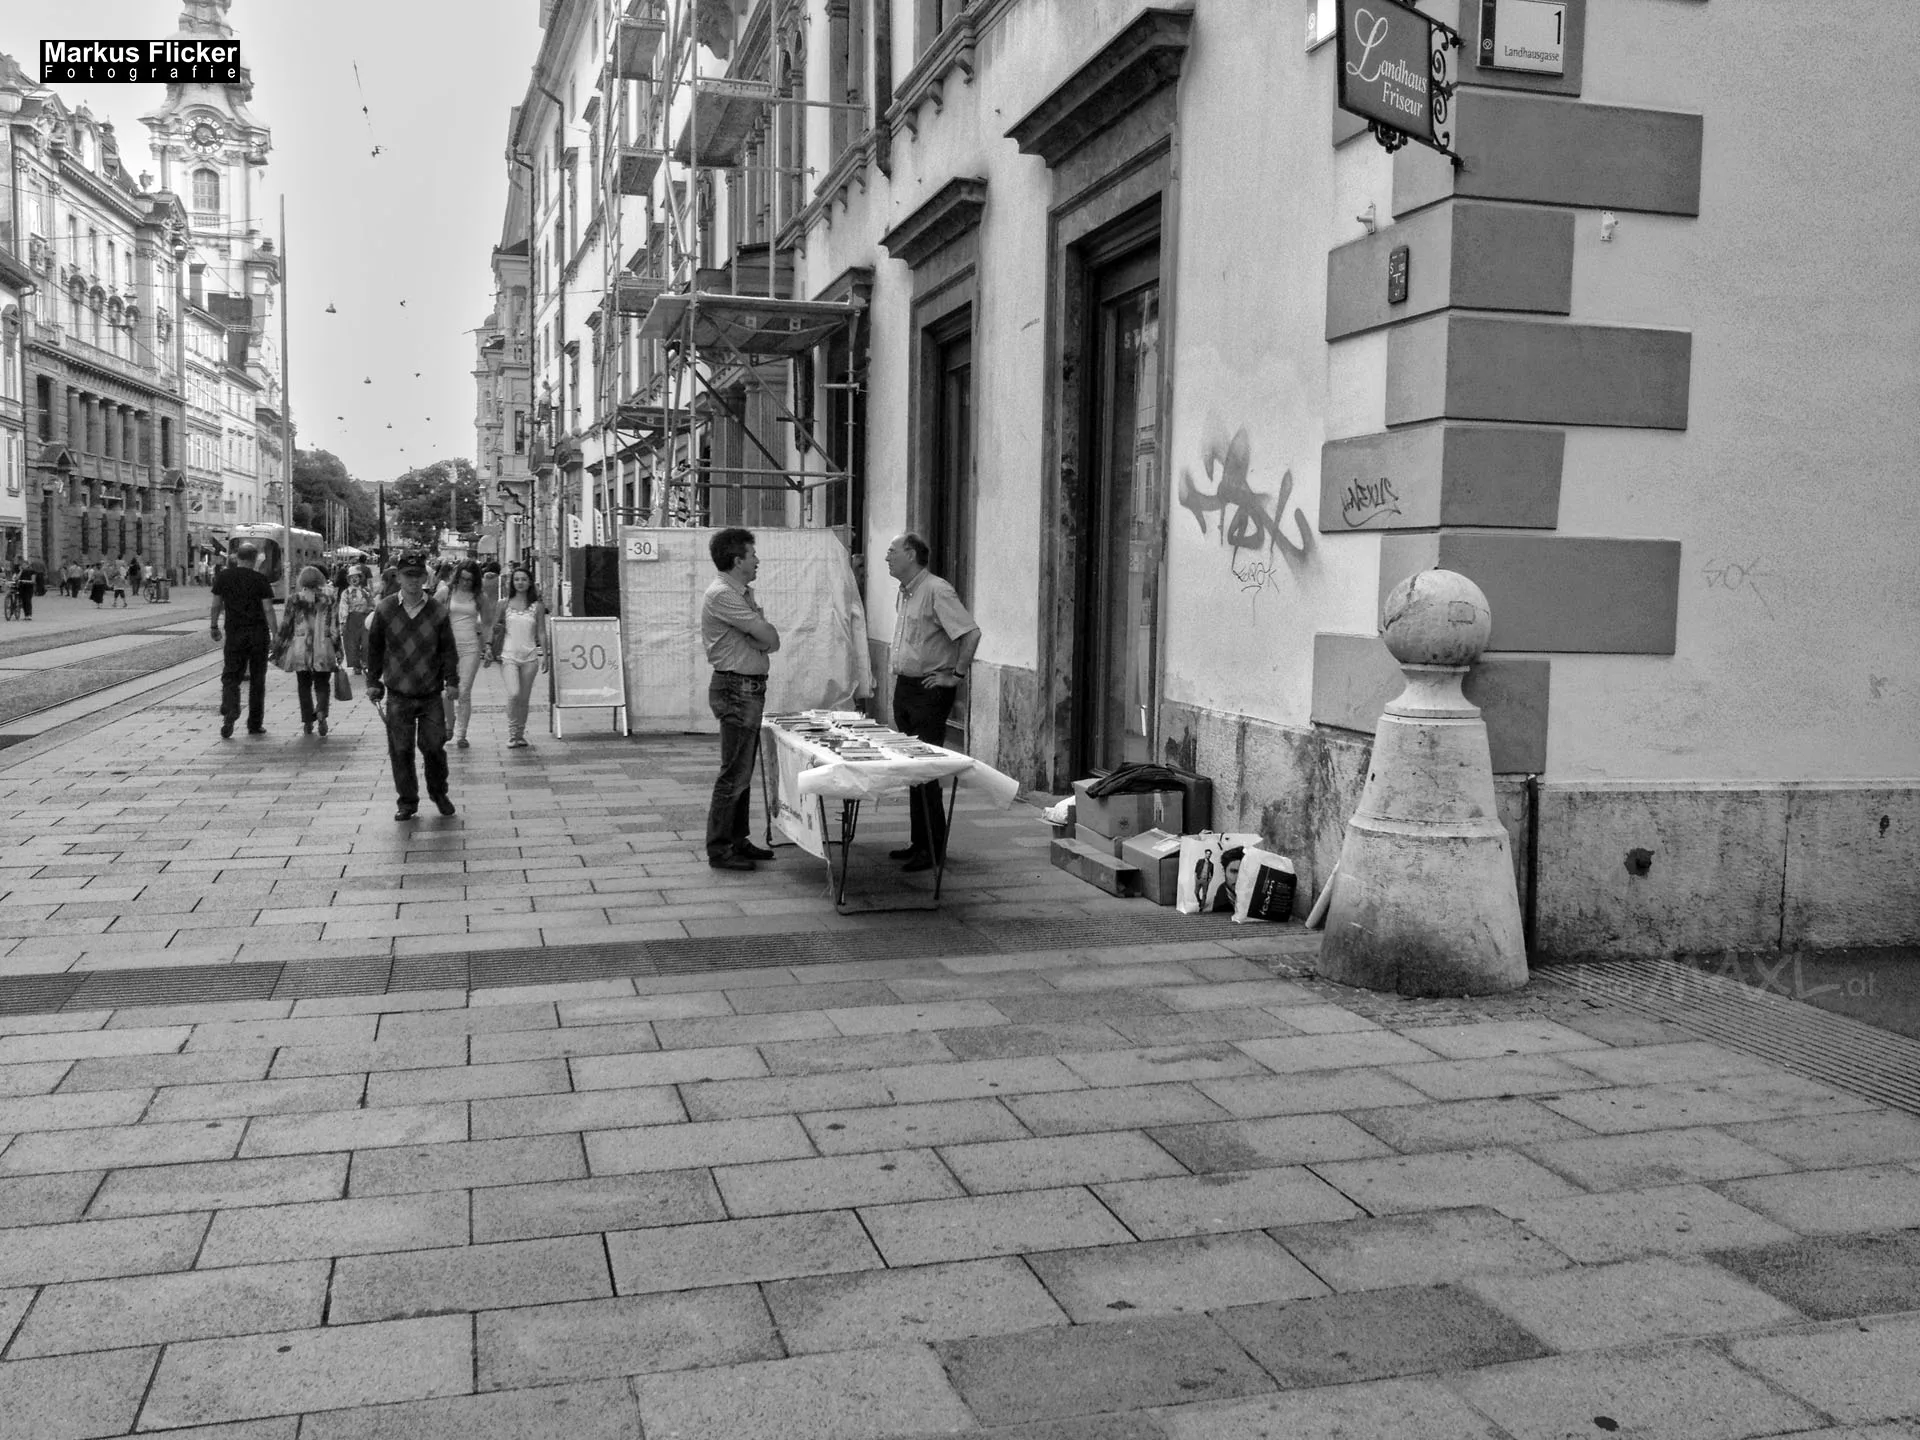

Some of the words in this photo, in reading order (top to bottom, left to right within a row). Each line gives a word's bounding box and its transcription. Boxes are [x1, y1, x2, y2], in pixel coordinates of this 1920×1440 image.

[1554, 10, 1562, 45] 1
[1346, 8, 1428, 94] Landhaus
[1504, 45, 1560, 63] Landhausgasse
[1382, 81, 1424, 117] Friseur
